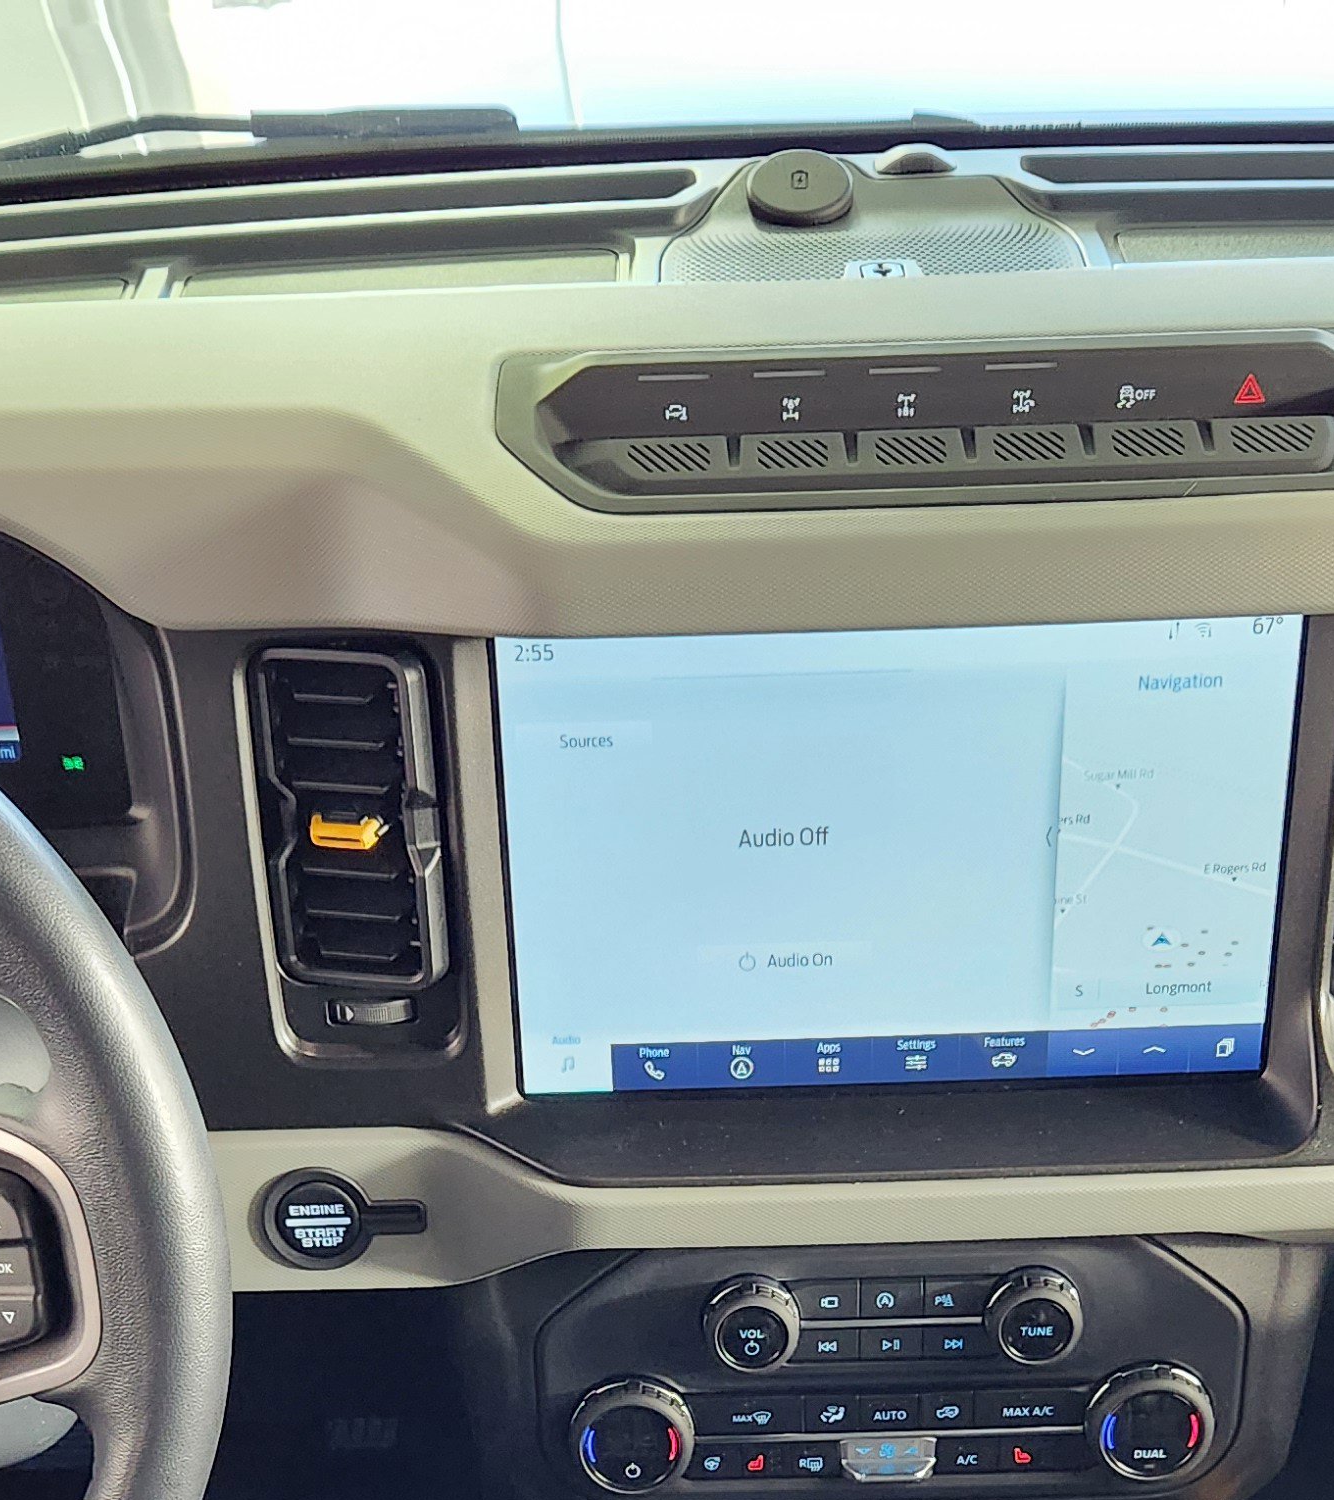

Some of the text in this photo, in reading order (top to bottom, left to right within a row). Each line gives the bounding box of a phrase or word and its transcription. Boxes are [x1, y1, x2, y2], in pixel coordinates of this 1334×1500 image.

[1134, 389, 1156, 400] OFF
[1252, 616, 1284, 635] 67°
[514, 643, 555, 662] 2:55
[1138, 674, 1223, 692] Navigation
[559, 734, 613, 749] Sources
[1083, 769, 1115, 783] Sugar
[1139, 769, 1155, 780] Rd
[1075, 813, 1091, 825] Rd
[739, 826, 830, 848] Audio Off
[1204, 862, 1267, 876] E Rogers Rd
[768, 952, 833, 968] Audio On
[1075, 985, 1084, 997] S
[1145, 980, 1212, 997] Longmont
[817, 1041, 841, 1054] Apps
[896, 1038, 937, 1052] Settings
[984, 1036, 1026, 1048] Features
[638, 1047, 670, 1058] Phone
[732, 1044, 751, 1056] Nav
[288, 1203, 345, 1217] ENGINE
[294, 1227, 346, 1239] START
[301, 1237, 343, 1248] STOP
[739, 1328, 765, 1339] VOL
[1020, 1326, 1054, 1337] TUNE
[872, 1410, 907, 1421] AUTO
[1002, 1405, 1054, 1418] MAX A/C
[732, 1413, 753, 1423] MAX
[1133, 1448, 1167, 1459] DUAL
[956, 1455, 978, 1466] A/C
